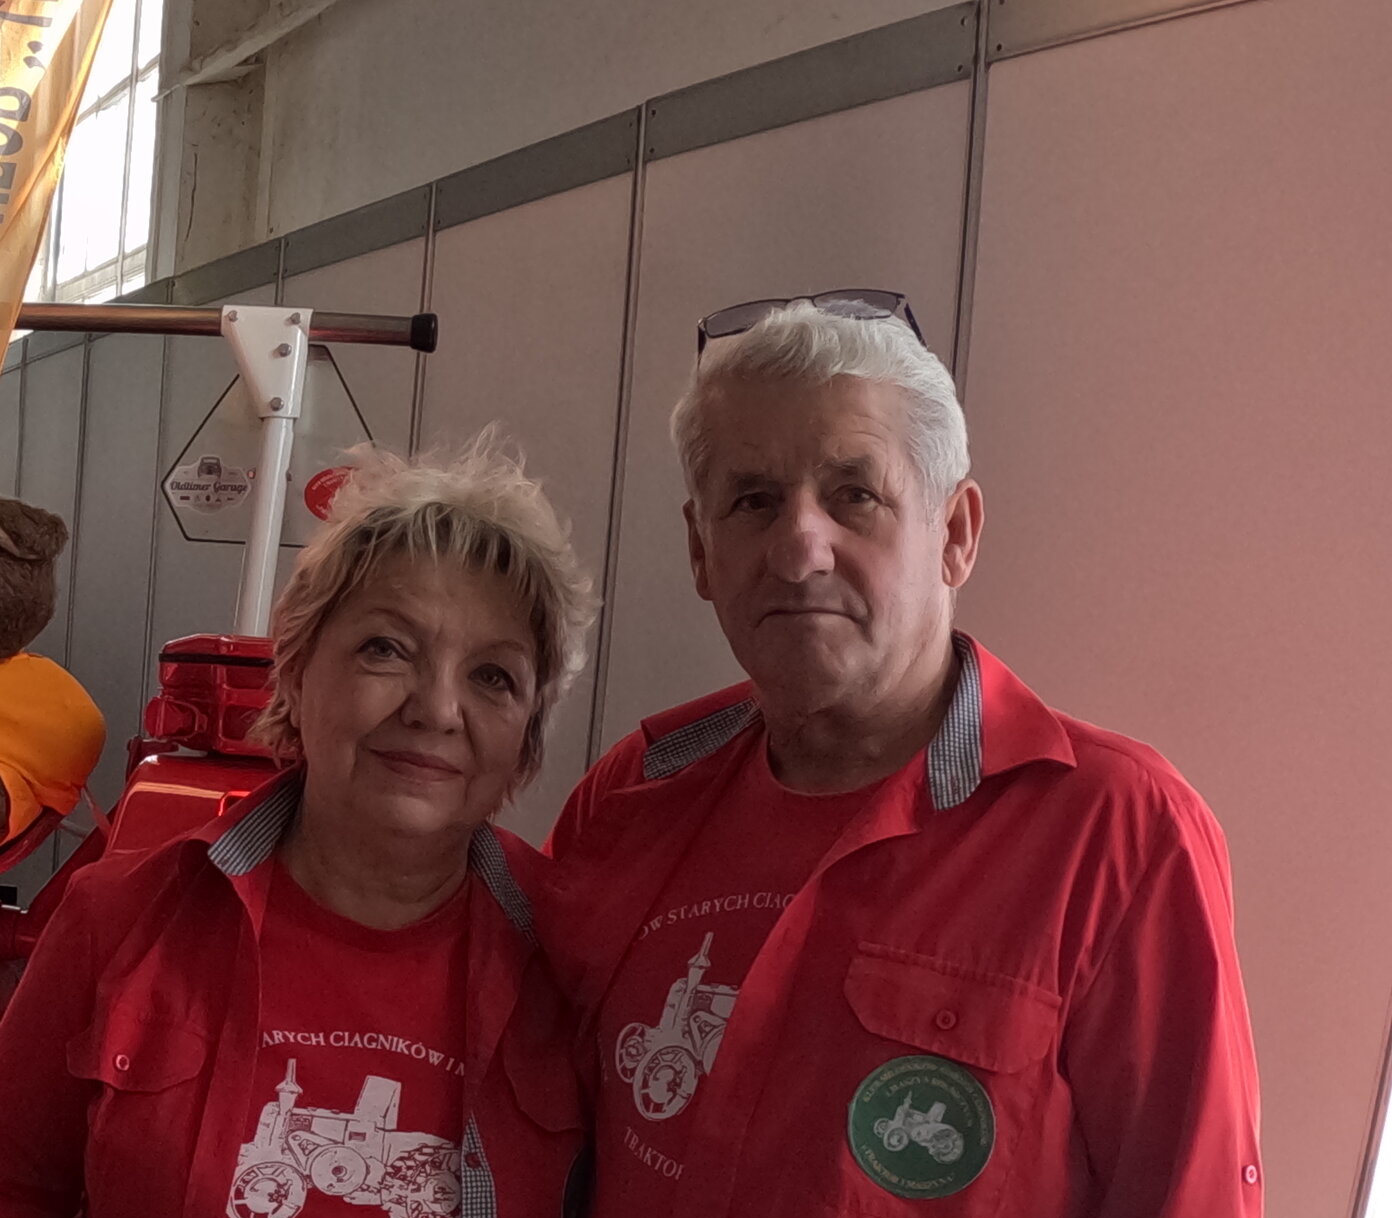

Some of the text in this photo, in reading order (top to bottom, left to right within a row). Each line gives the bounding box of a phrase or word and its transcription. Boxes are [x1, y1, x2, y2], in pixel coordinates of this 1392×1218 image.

[170, 481, 249, 494] Oldtimer Garage
[668, 893, 750, 925] STARYCH
